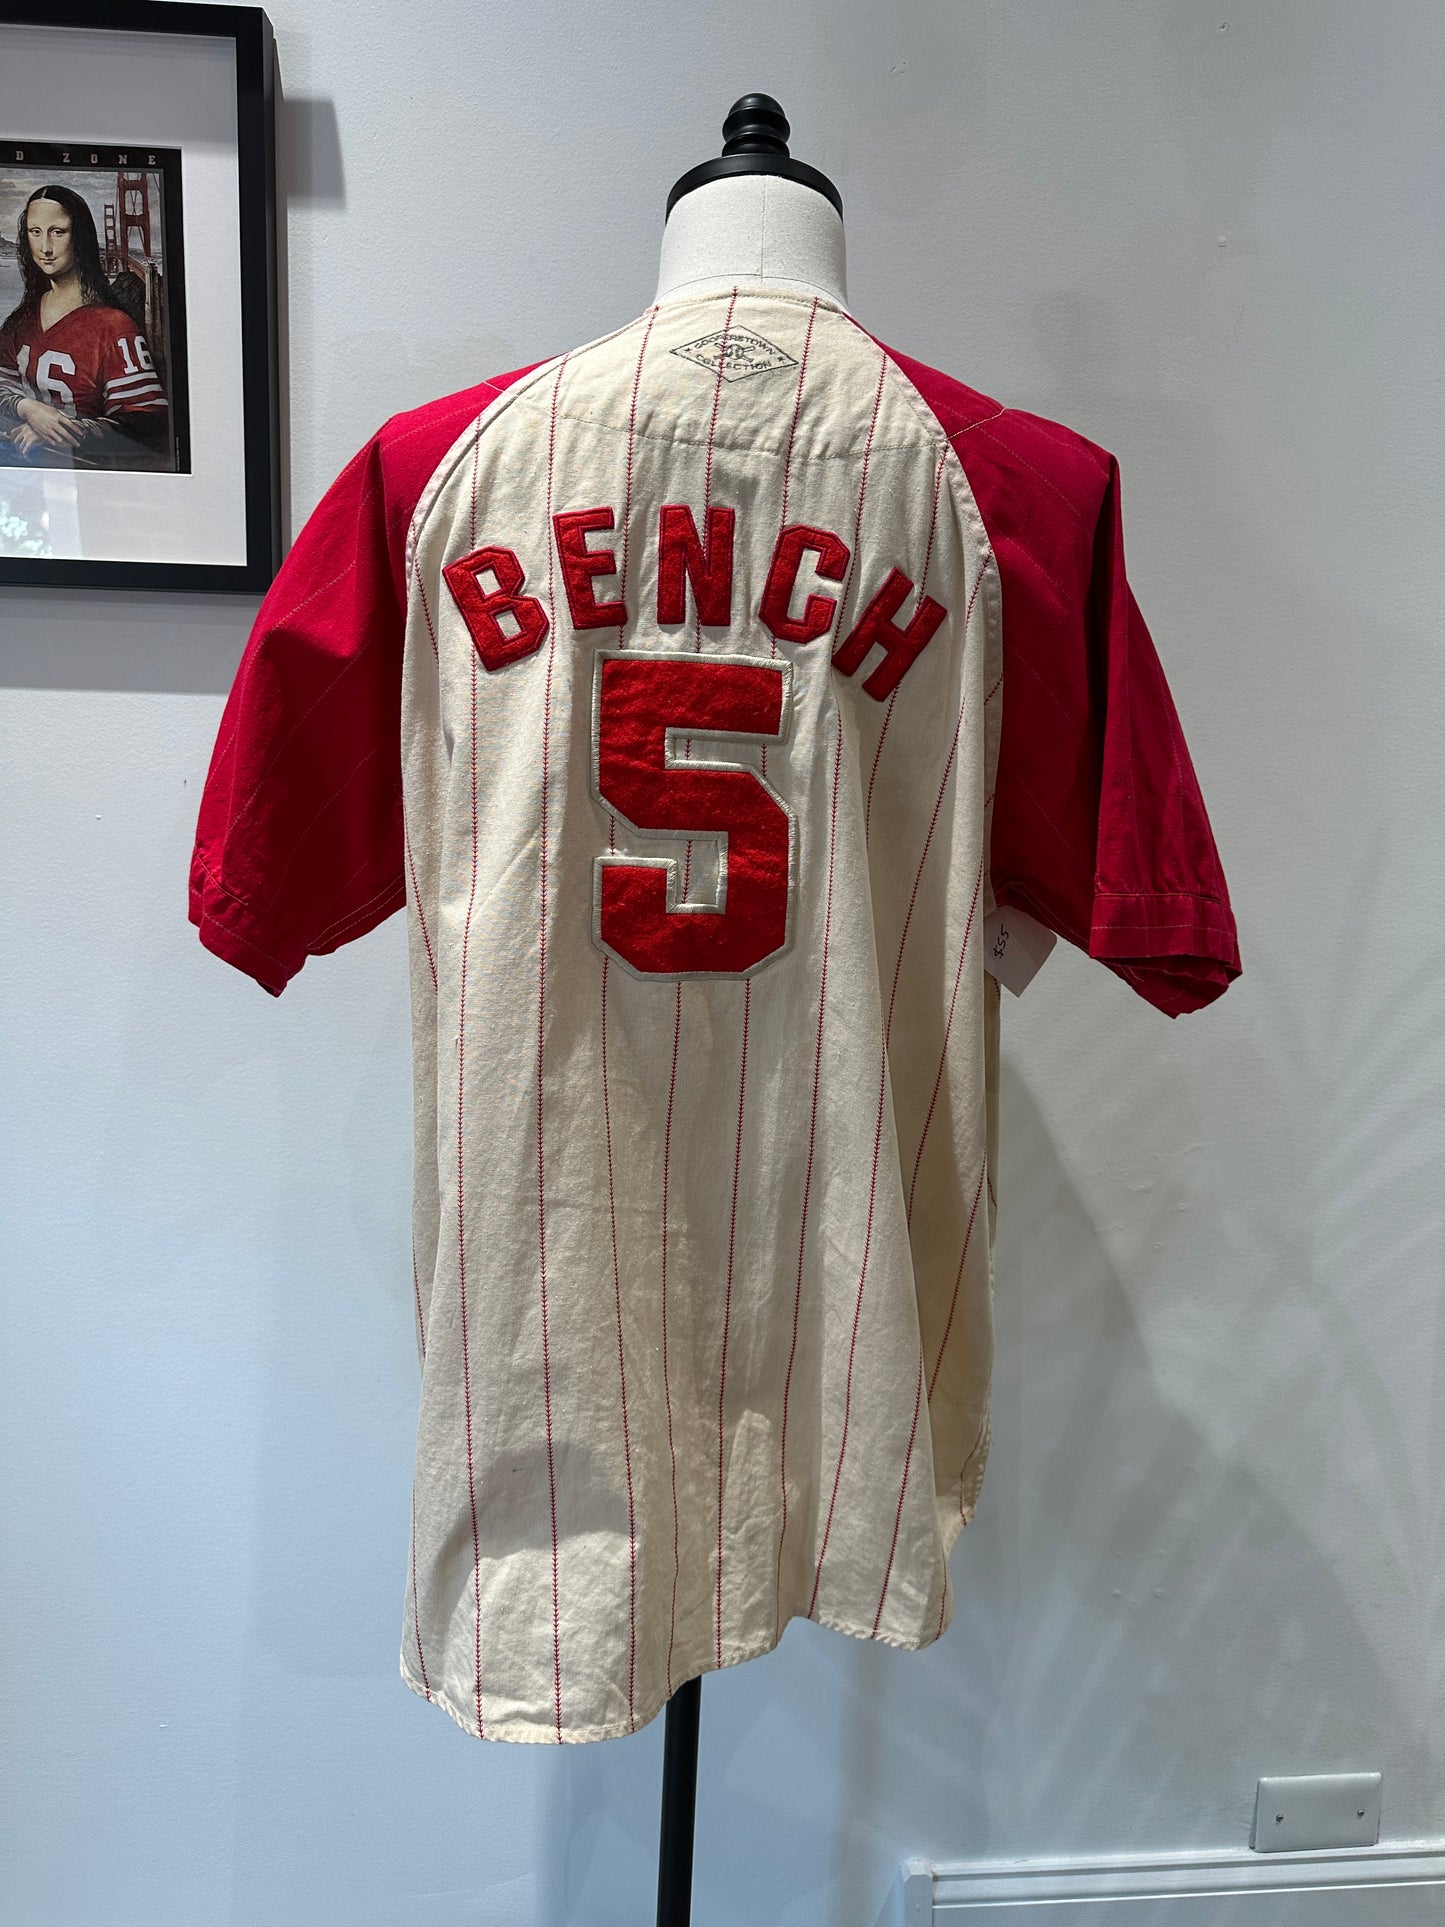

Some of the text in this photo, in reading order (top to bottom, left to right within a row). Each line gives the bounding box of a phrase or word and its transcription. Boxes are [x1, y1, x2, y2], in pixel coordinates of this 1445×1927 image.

[62, 152, 156, 165] ZONE
[16, 344, 77, 420] 16
[117, 335, 154, 375] 16
[442, 505, 948, 702] BENCH
[591, 649, 799, 982] 5
[992, 922, 1010, 960] $55
